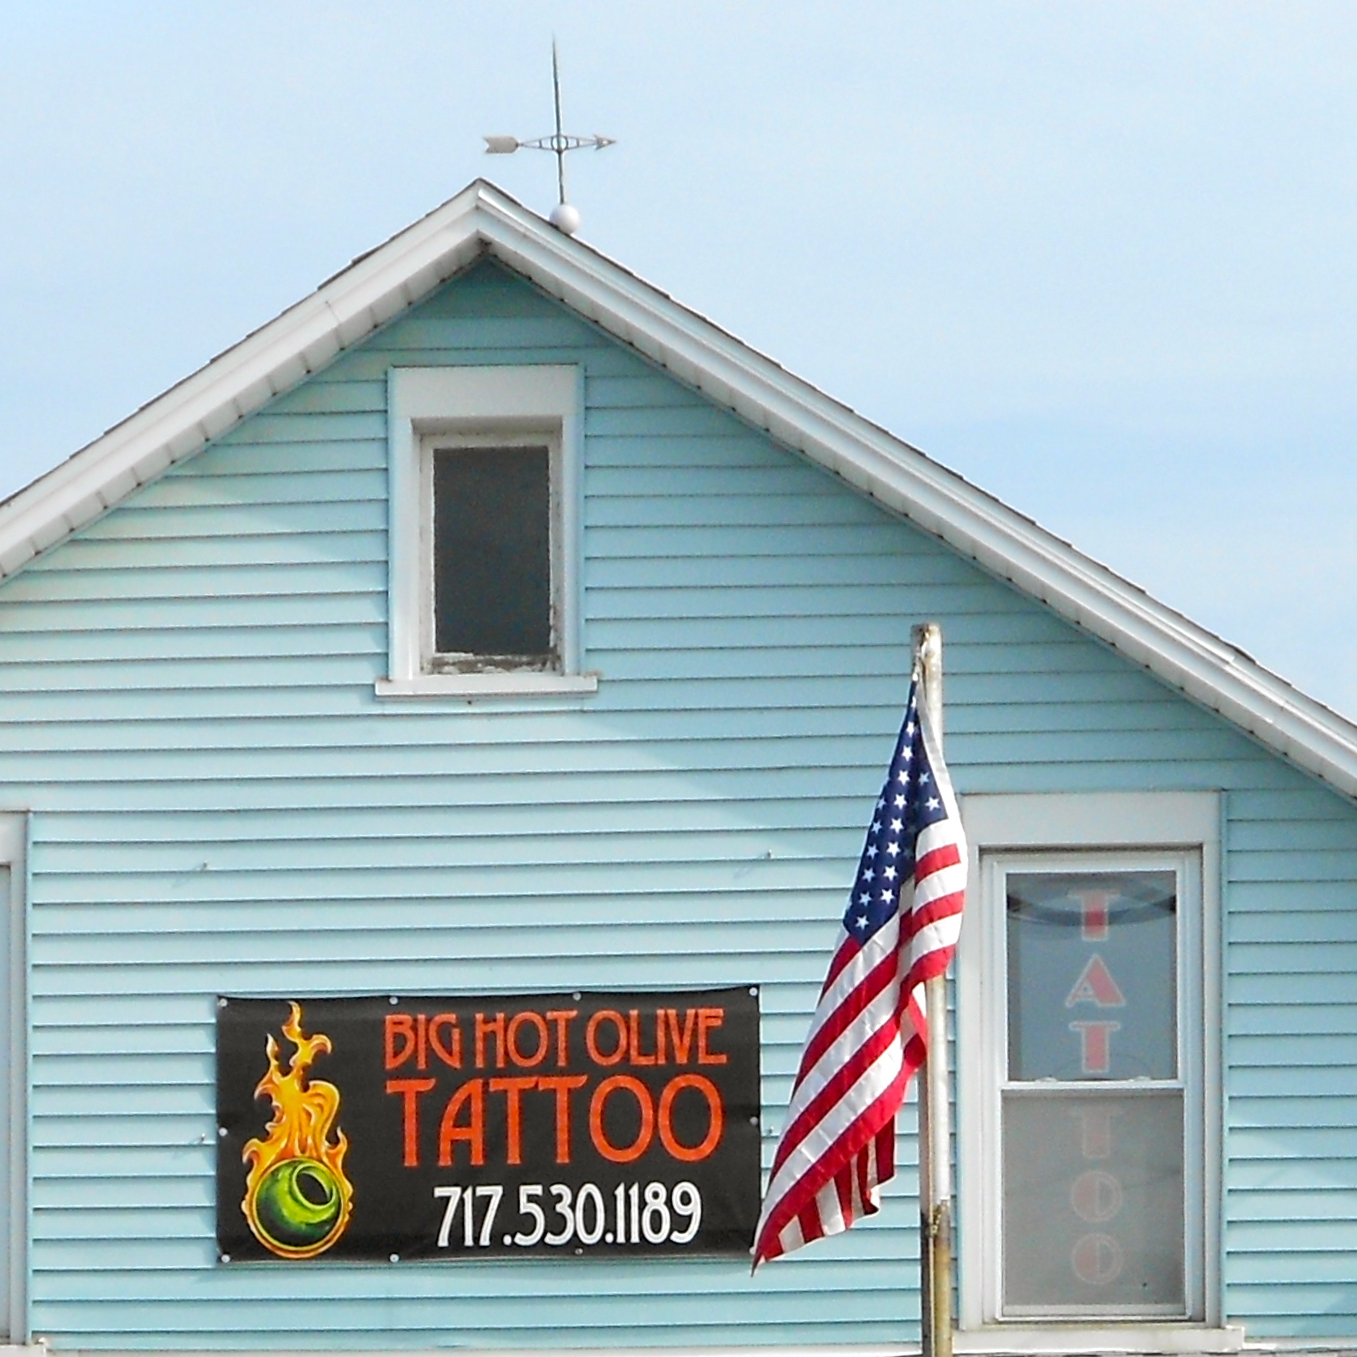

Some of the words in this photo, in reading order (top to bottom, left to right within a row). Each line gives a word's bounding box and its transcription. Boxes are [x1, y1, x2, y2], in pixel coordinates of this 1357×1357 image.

[384, 1013, 461, 1070] BIG
[474, 1010, 578, 1068] HOT
[585, 1008, 728, 1065] OLIVE
[385, 1074, 723, 1167] TATTOO
[1064, 889, 1126, 1284] TATTOO
[433, 1181, 703, 1248] 717.530.1189
